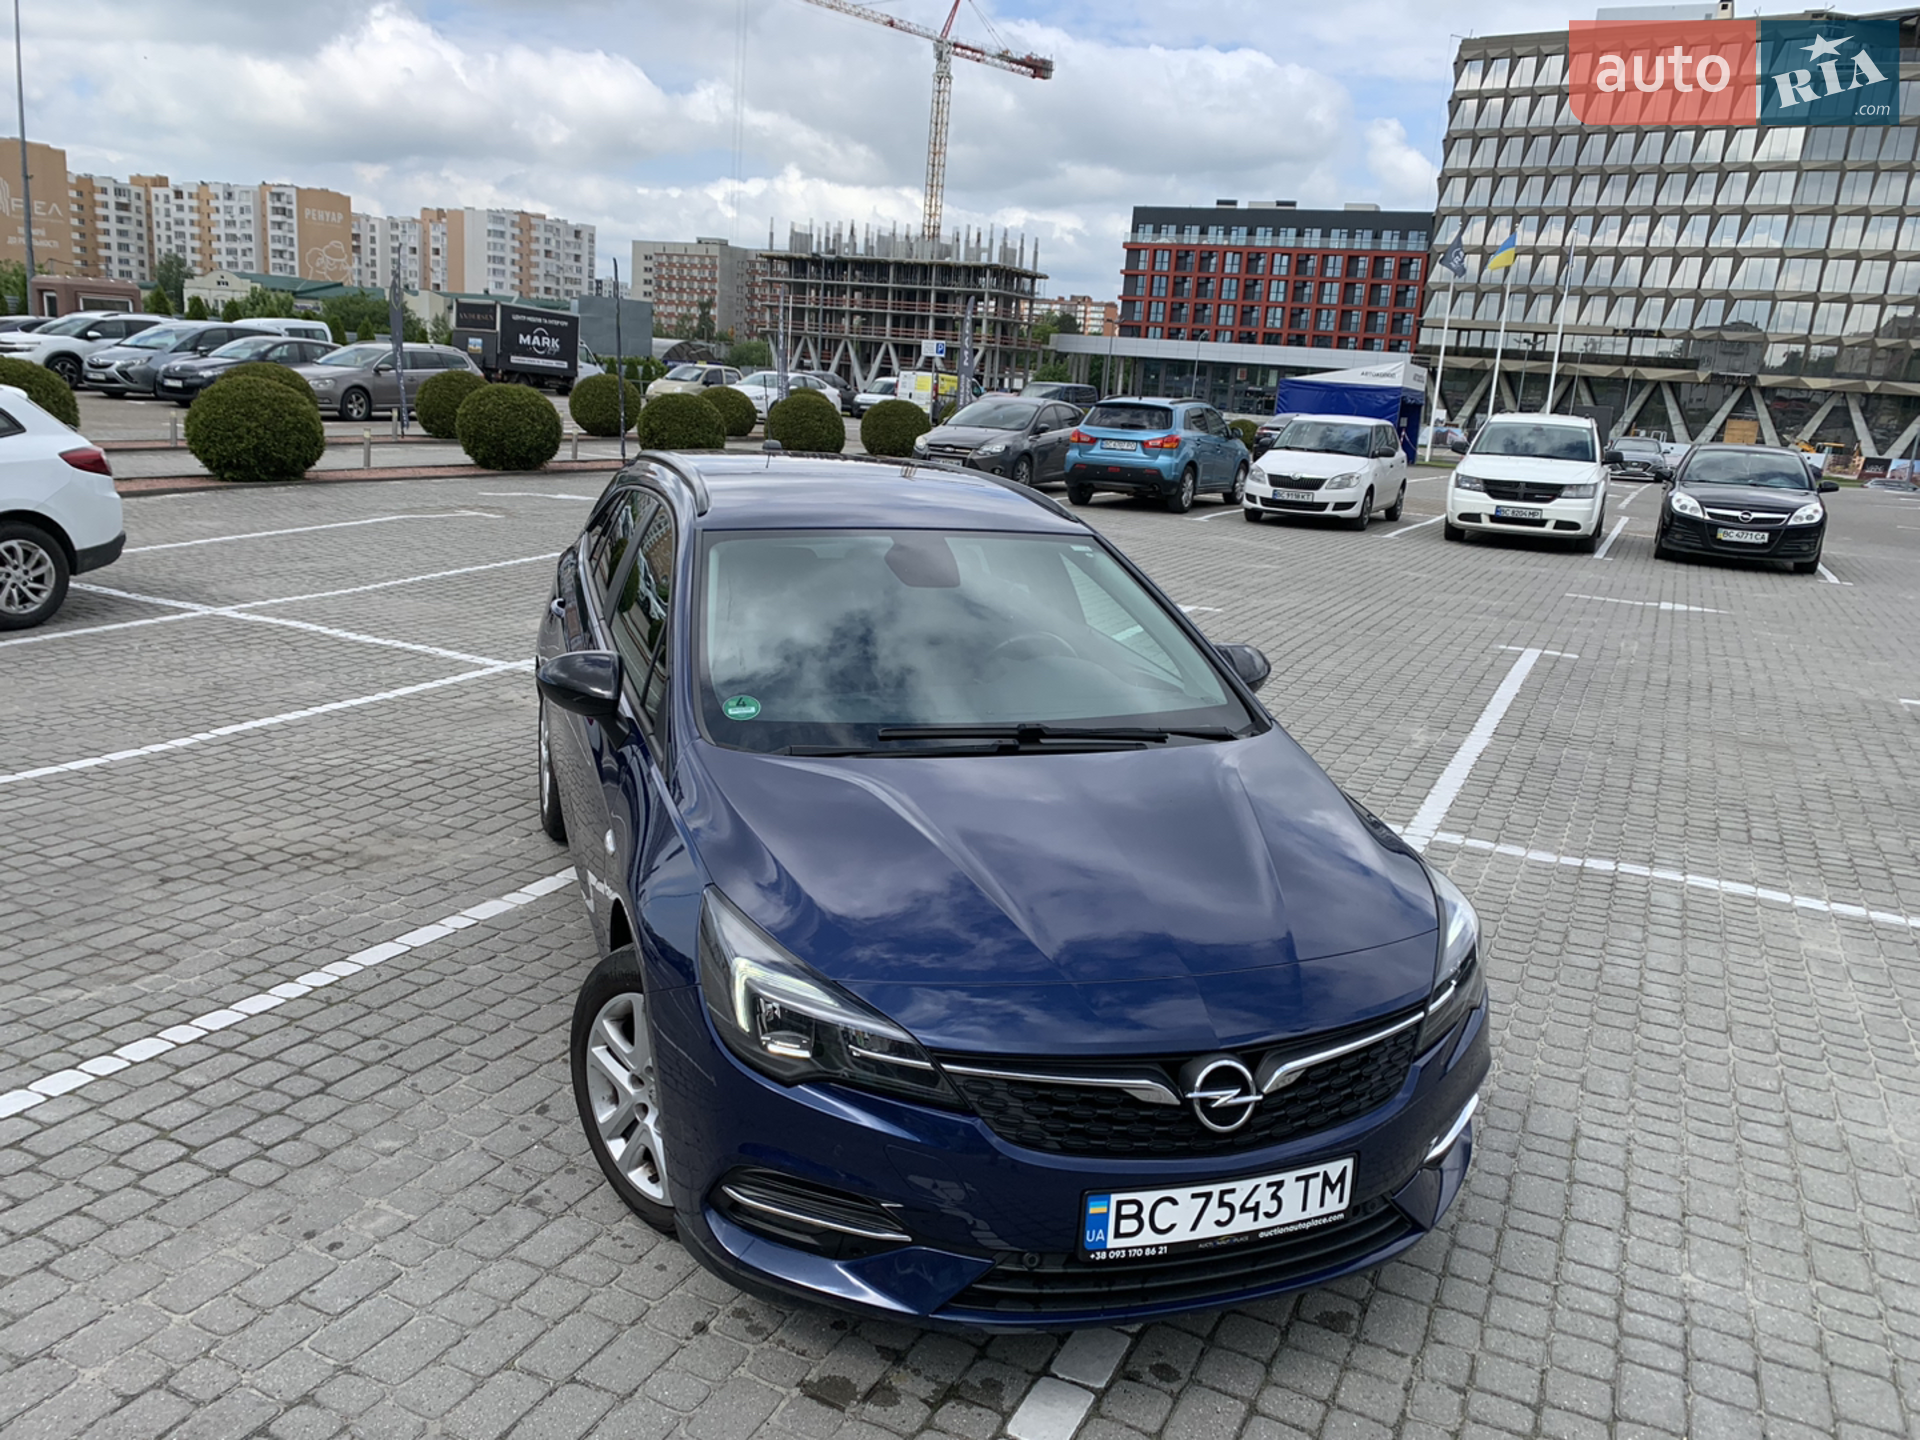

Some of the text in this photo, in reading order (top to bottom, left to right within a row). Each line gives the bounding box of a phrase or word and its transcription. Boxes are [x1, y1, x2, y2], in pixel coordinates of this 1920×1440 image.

[304, 207, 344, 224] РЕНУАР
[518, 333, 560, 349] MARK
[1722, 530, 1734, 539] BC
[1754, 533, 1766, 541] CA
[736, 696, 747, 708] 4
[1113, 1165, 1348, 1240] BC 7543 TM
[1258, 1212, 1345, 1239] auctionautoplace.com
[1086, 1228, 1105, 1242] UA
[1090, 1246, 1168, 1261] +38 093 170 86 21
